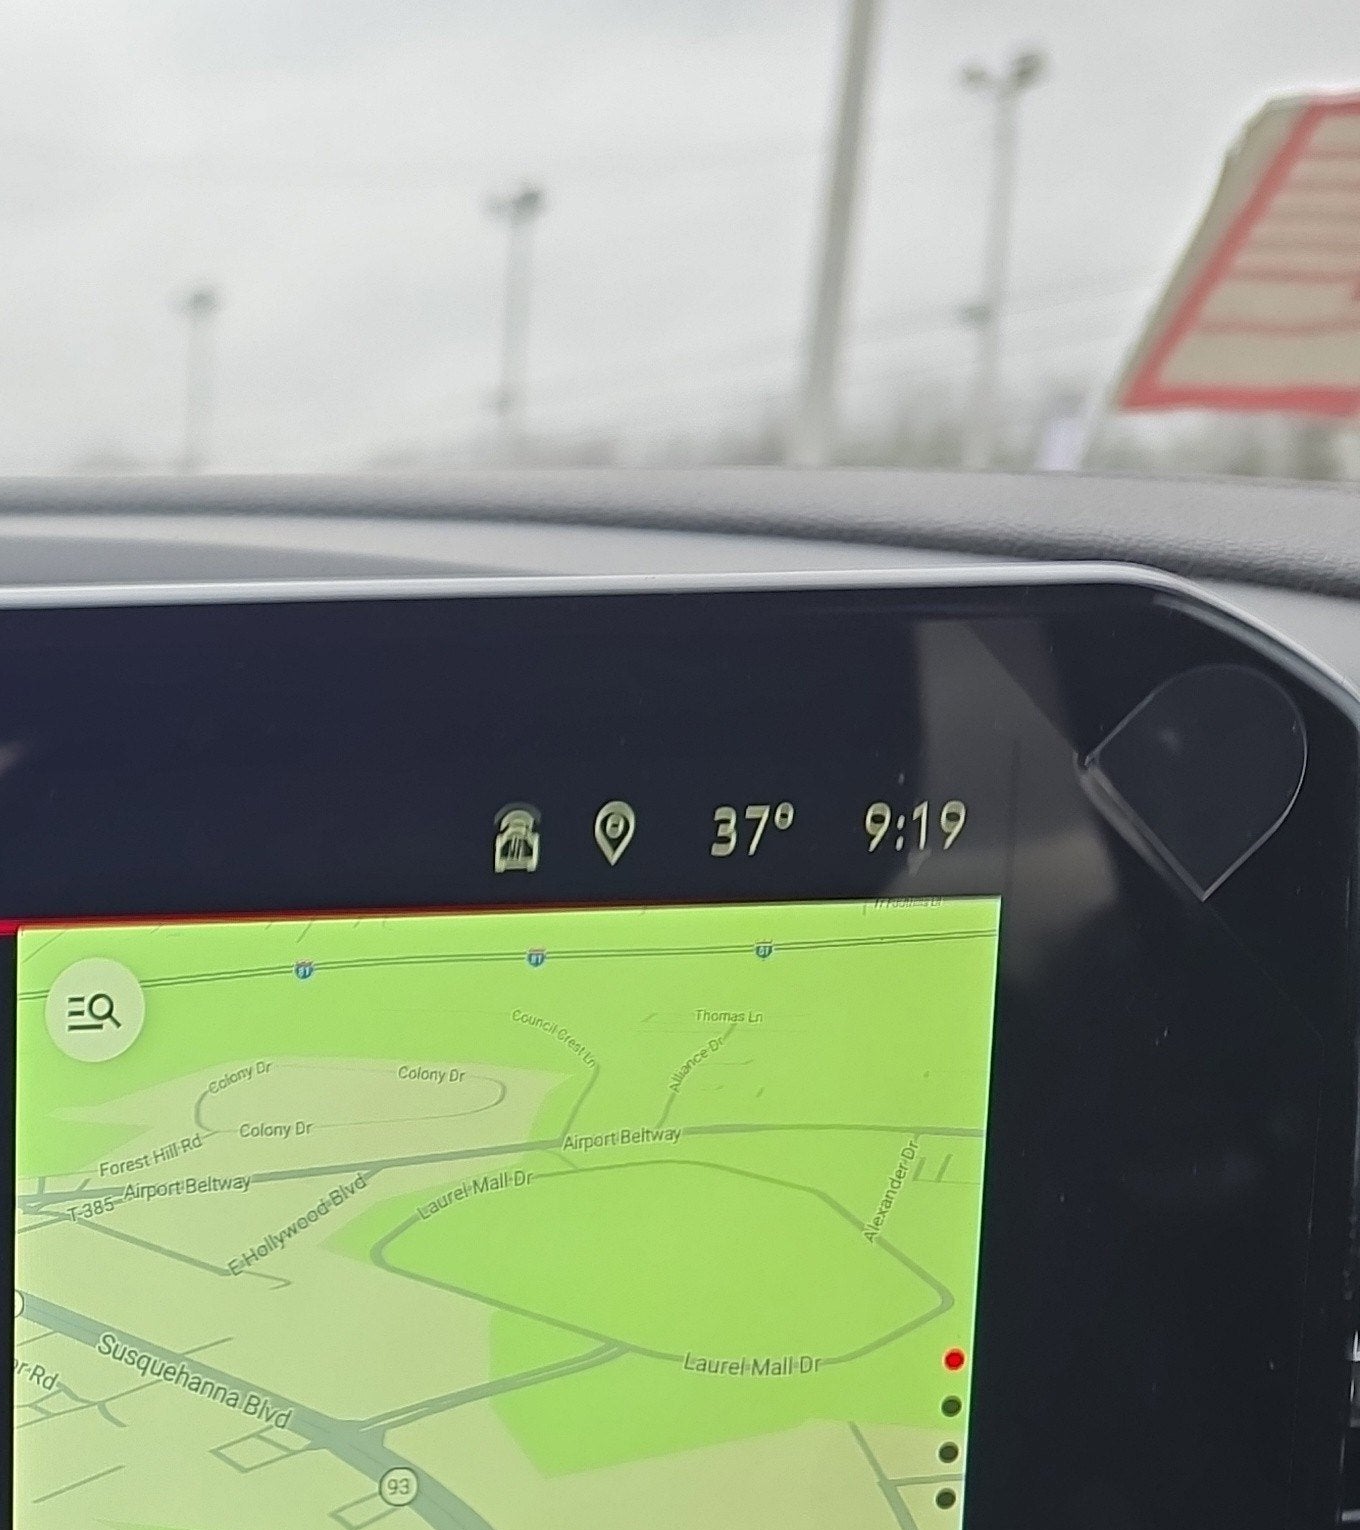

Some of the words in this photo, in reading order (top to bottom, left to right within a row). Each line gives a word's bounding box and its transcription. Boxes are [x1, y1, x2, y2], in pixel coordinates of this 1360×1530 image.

[864, 801, 967, 853] 9:19
[696, 1009, 745, 1022] Thomas
[748, 1010, 763, 1023] Ln
[512, 1009, 558, 1035] Council
[557, 1028, 586, 1056] Crest
[582, 1051, 596, 1069] Ln
[208, 1065, 253, 1094] Colony
[256, 1061, 272, 1074] Dr
[398, 1065, 446, 1084] Colony
[449, 1067, 465, 1082] Dr
[669, 1048, 708, 1093] Alliance
[709, 1037, 723, 1052] Dr
[239, 1122, 291, 1139] Colony
[295, 1121, 313, 1135] Dr
[563, 1130, 616, 1152] Airport
[621, 1125, 682, 1147] Beltway
[99, 1155, 155, 1177] Forest
[153, 1143, 179, 1164] Hill
[182, 1133, 202, 1154] Rd
[123, 1181, 181, 1202] Airport
[186, 1174, 251, 1194] Beltway
[417, 1184, 469, 1220] Laurel
[472, 1171, 508, 1195] Mall
[514, 1170, 534, 1186] Dr
[864, 1161, 909, 1243] Alexander
[901, 1140, 918, 1160] Dr
[67, 1197, 115, 1222] T-385
[227, 1259, 243, 1276] E
[242, 1199, 329, 1267] Hollywood
[329, 1172, 367, 1207] Blvd
[29, 1364, 59, 1391] Rd
[684, 1352, 746, 1375] Laurel
[751, 1357, 793, 1376] Mall
[799, 1356, 821, 1373] Dr
[98, 1334, 239, 1410] Susquehanna
[242, 1394, 292, 1429] Blvd
[387, 1478, 410, 1495] 93
